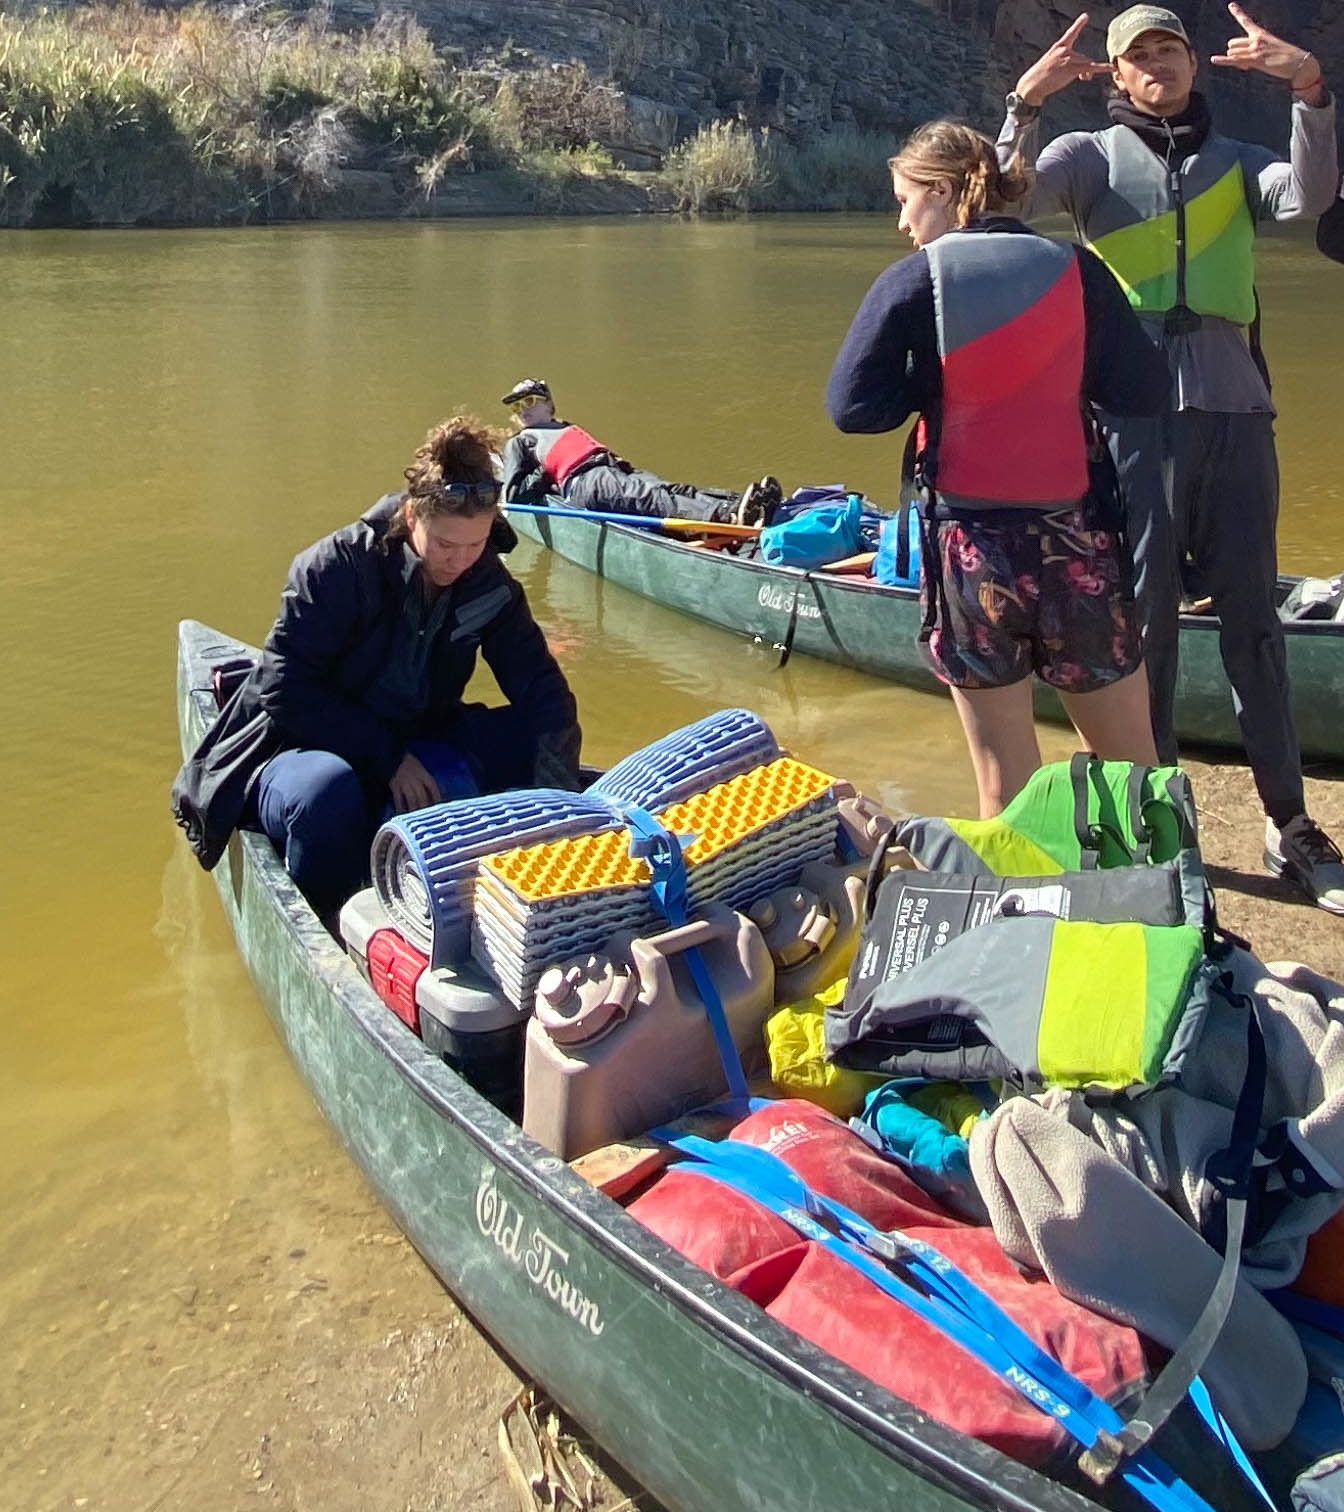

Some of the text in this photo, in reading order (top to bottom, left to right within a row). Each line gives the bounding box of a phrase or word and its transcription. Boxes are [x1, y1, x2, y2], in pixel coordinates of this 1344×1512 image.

[758, 582, 782, 610] Old
[911, 897, 929, 924] PLUS
[887, 897, 914, 982] NIVERSAL PLUS
[476, 1180, 605, 1336] Old Town
